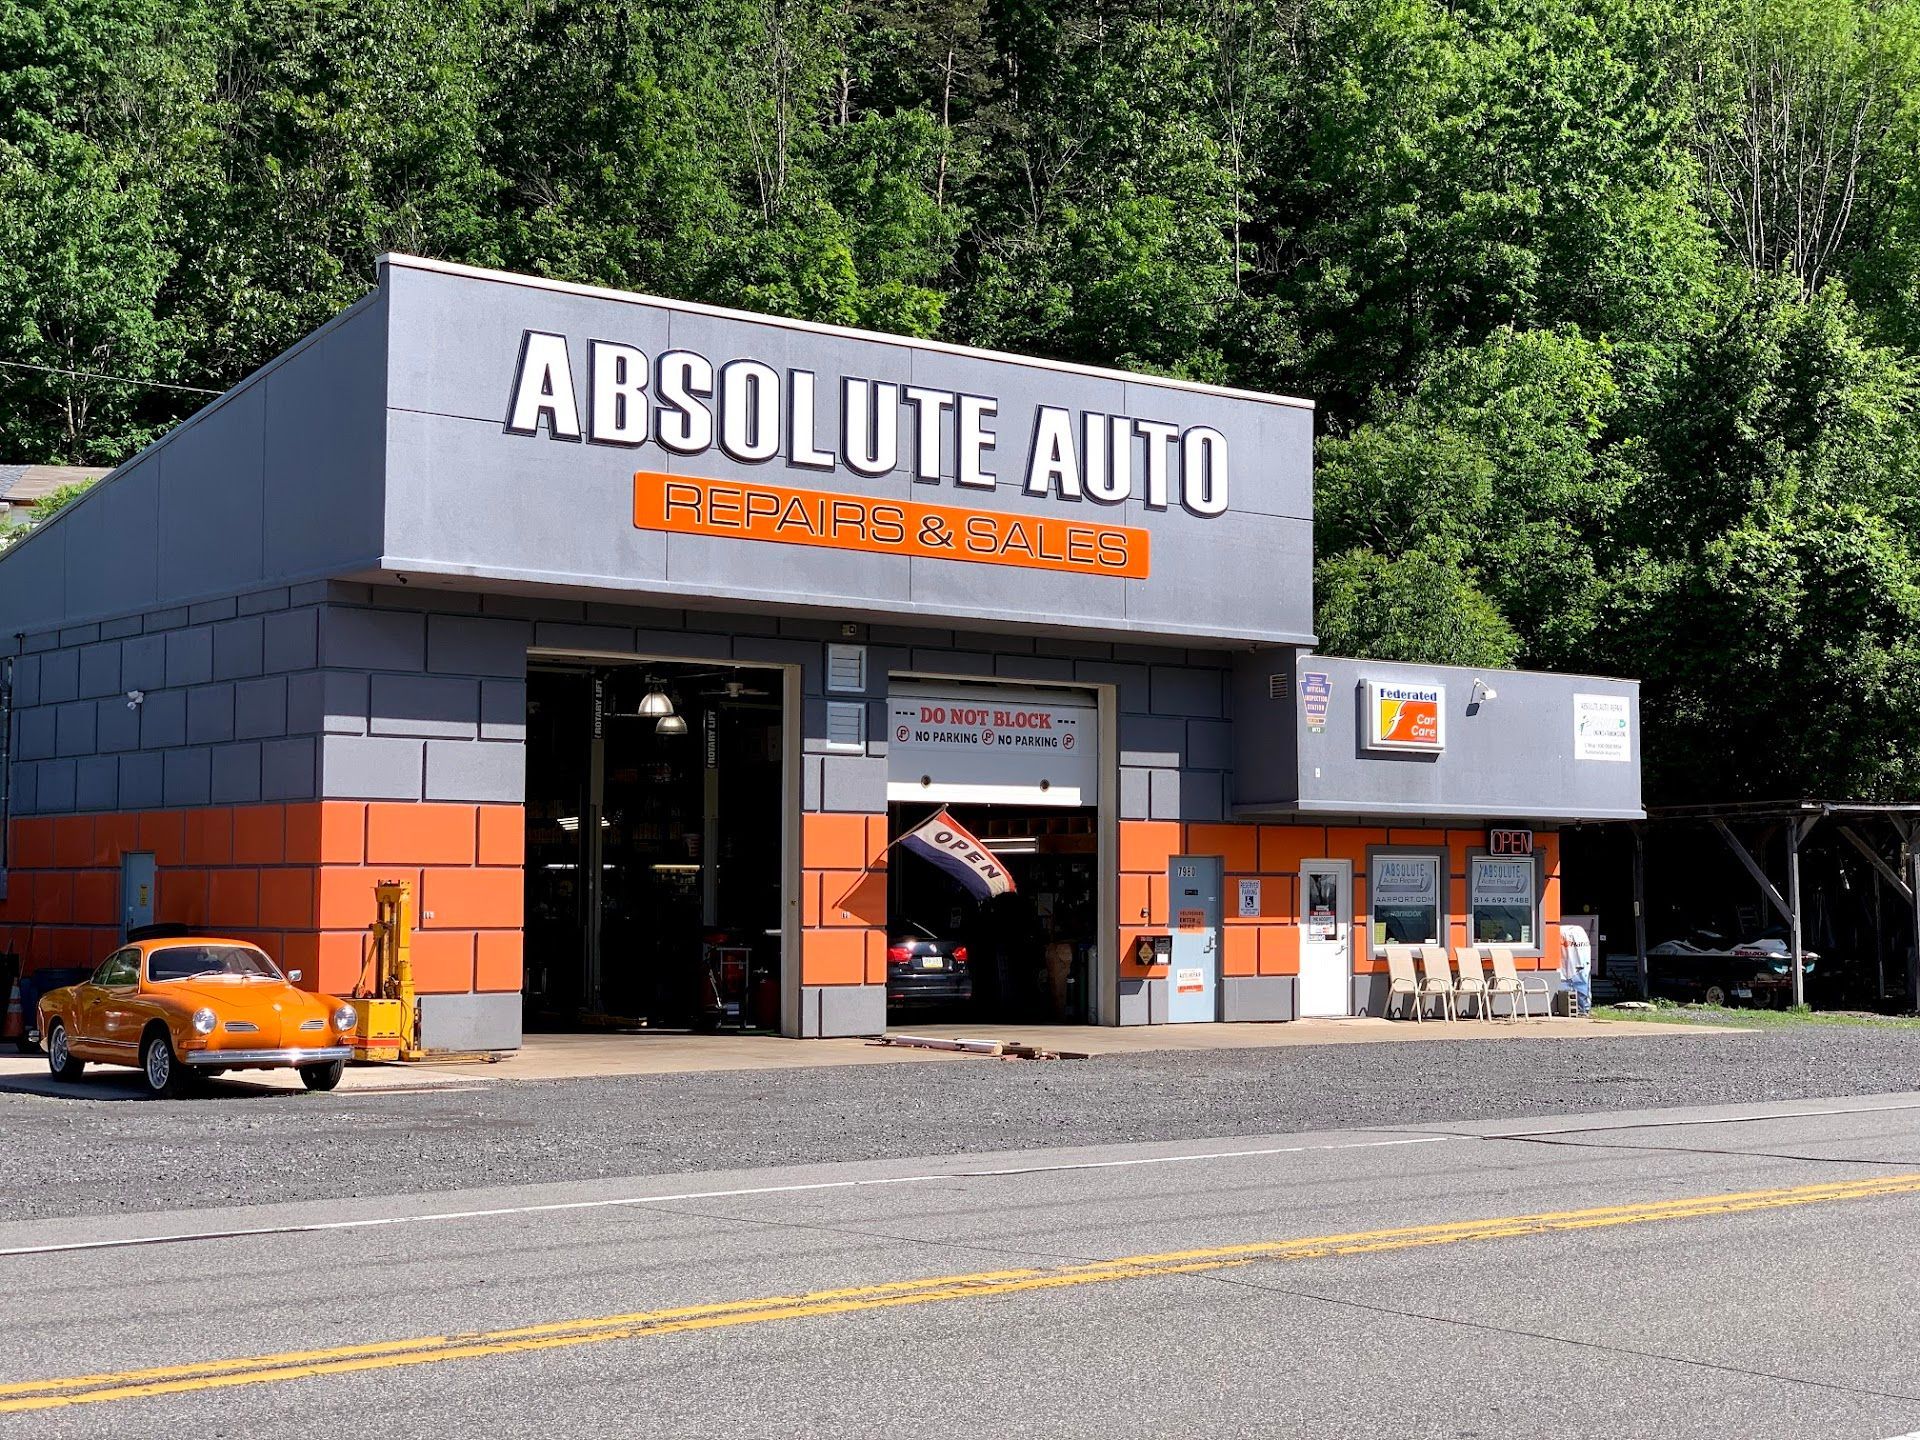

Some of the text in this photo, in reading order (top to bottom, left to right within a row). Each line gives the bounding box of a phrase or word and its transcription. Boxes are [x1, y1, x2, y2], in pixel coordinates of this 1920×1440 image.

[503, 328, 1228, 518] ABSOLUTE AUTO
[663, 481, 1128, 568] REPAIRS & SALES
[595, 679, 603, 698] LIFT
[1380, 688, 1437, 701] Federated
[920, 706, 1052, 729] DO NOT BLOCK
[1416, 713, 1436, 725] Car
[707, 710, 716, 764] ROTARY LIFT
[915, 730, 978, 744] NO PARKING
[1411, 725, 1436, 737] Care
[998, 734, 1058, 748] NO PARKING
[1492, 831, 1532, 854] OPEN
[934, 830, 1001, 879] OPEN
[1385, 863, 1424, 877] ABSOLUTE
[1483, 864, 1520, 878] ABSOLUTE
